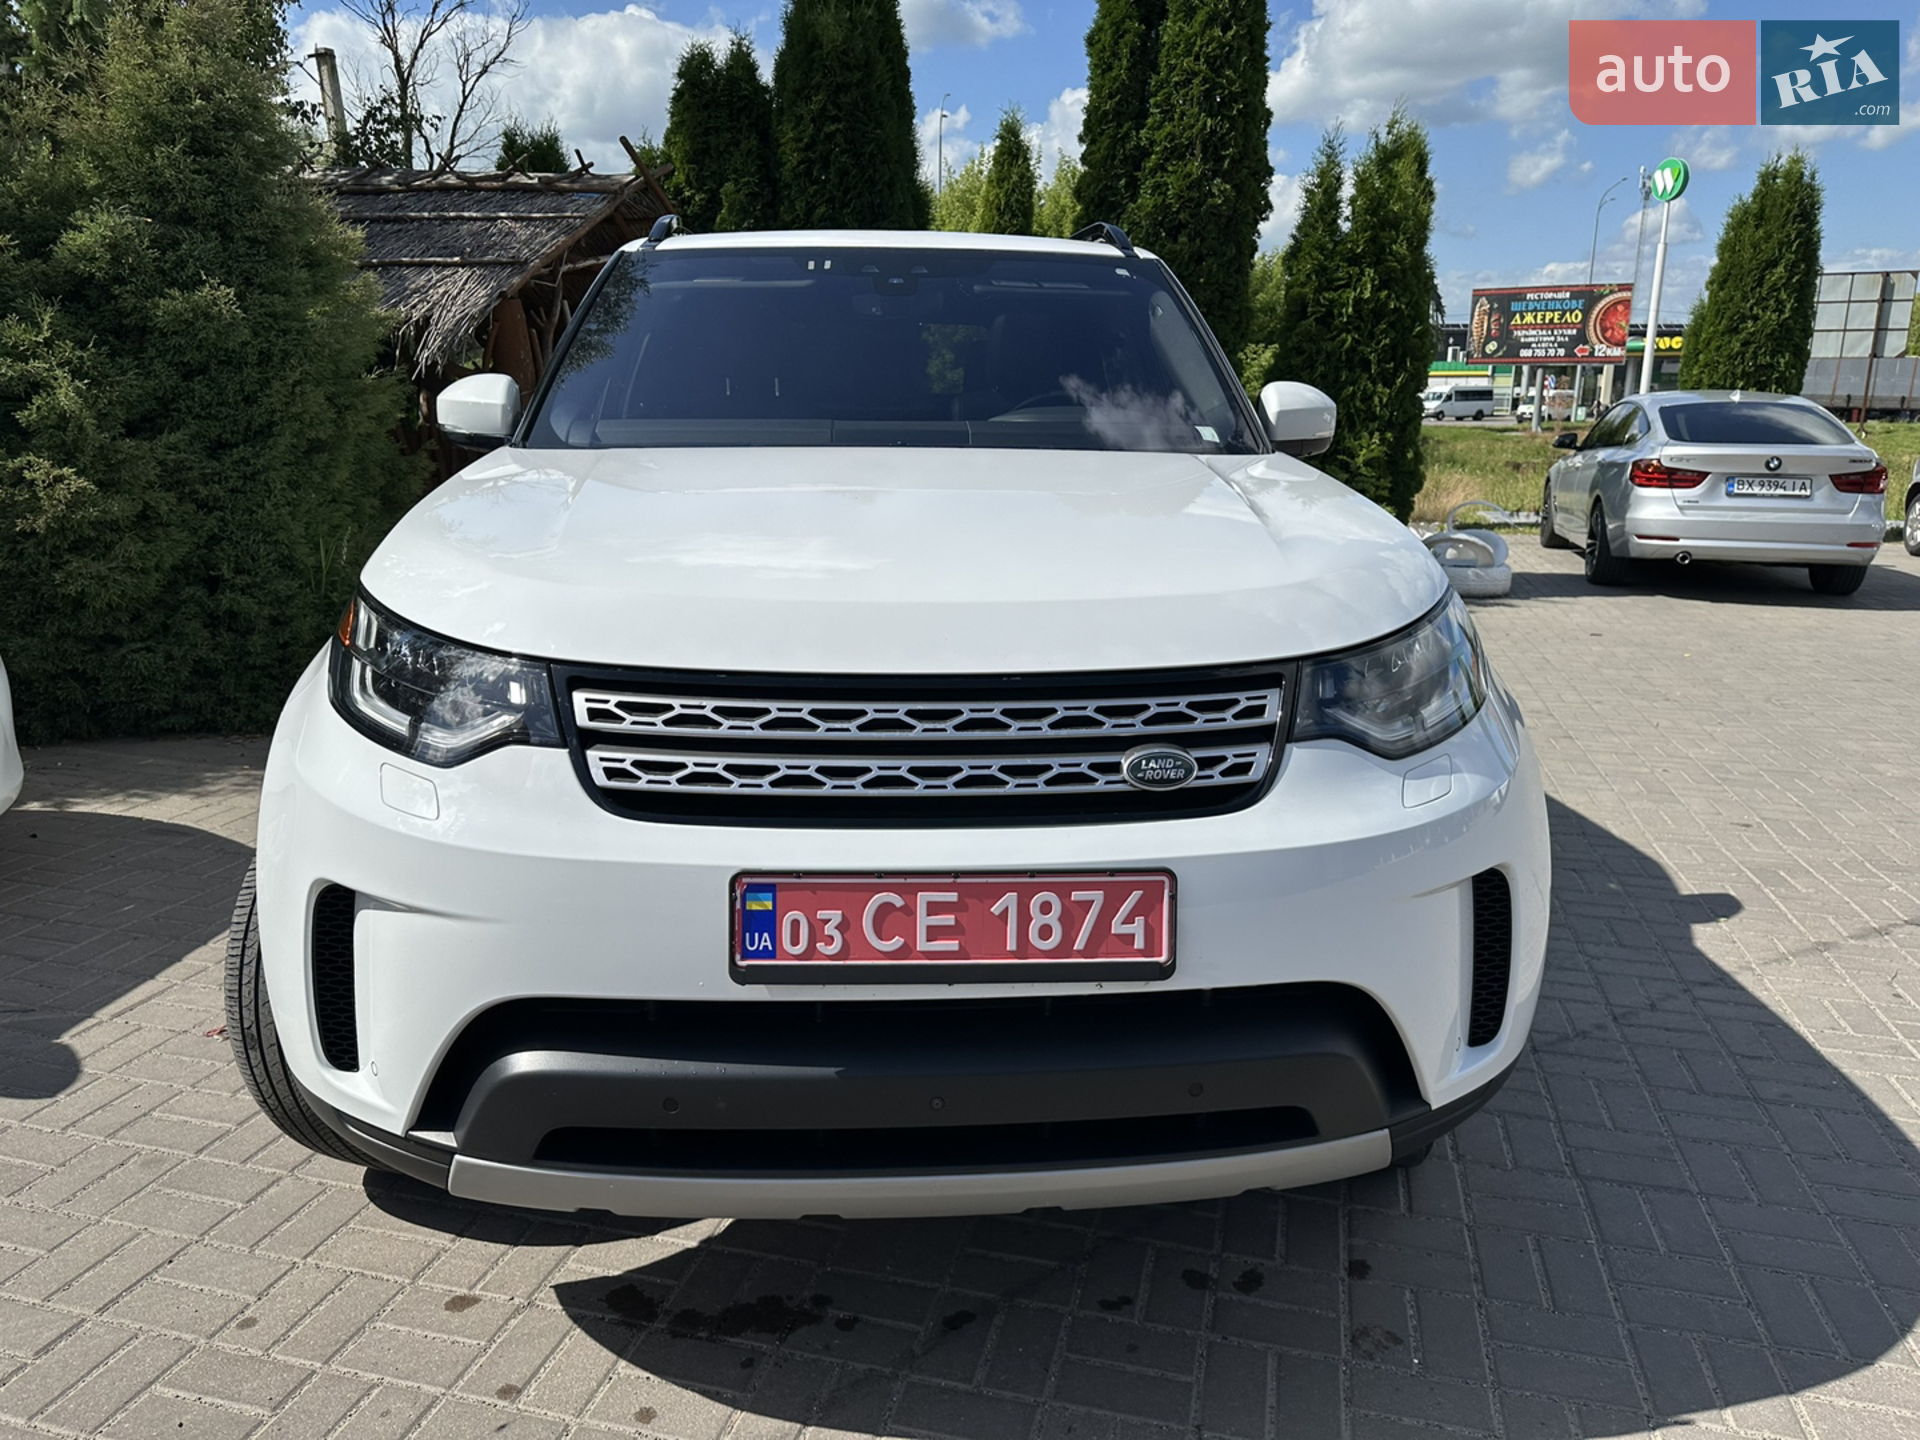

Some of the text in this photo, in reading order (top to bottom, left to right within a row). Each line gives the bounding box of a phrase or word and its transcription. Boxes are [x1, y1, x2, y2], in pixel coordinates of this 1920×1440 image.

[1511, 299, 1585, 312] ШЕВЧЕНКОВЕ
[1510, 309, 1582, 326] ДЖЕРЕЛО
[1736, 479, 1755, 491] BX
[1758, 480, 1787, 492] 9394
[1141, 758, 1174, 770] LAND
[1144, 769, 1185, 780] ROVER
[782, 890, 1145, 956] 03 CE 1874
[745, 931, 773, 952] UA
